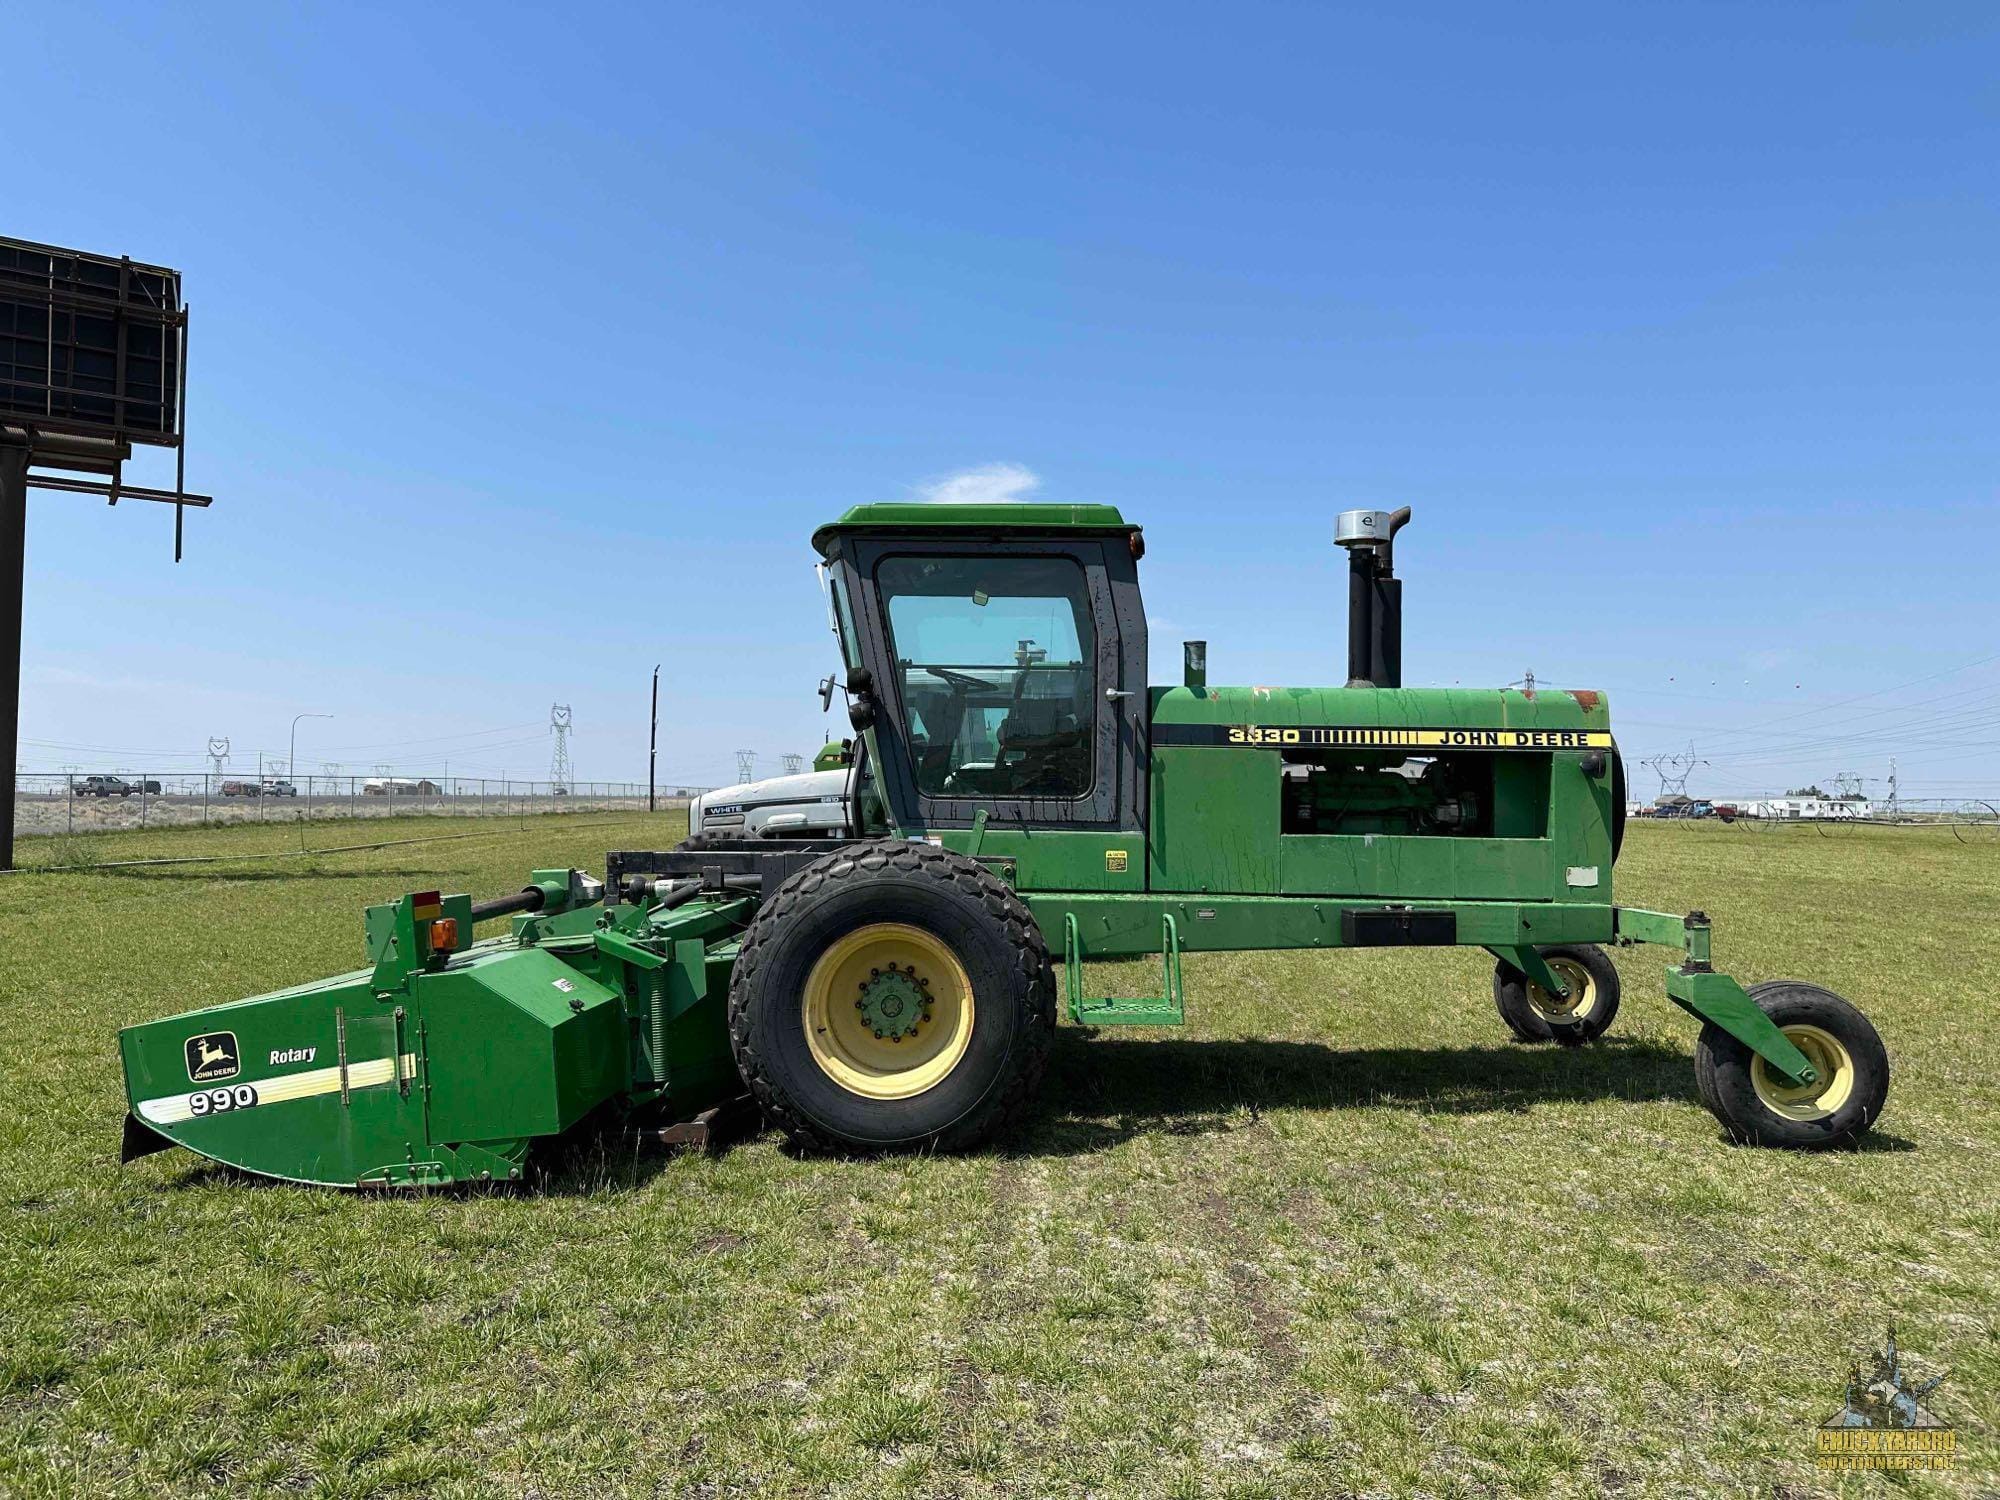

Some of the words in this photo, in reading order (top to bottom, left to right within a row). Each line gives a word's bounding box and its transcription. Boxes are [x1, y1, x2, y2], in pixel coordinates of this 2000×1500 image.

[1440, 731, 1499, 745] JOHN
[1515, 733, 1588, 746] DEERE
[710, 805, 743, 815] WHITE
[269, 1047, 316, 1065] Rotary
[193, 1070, 214, 1080] JOHN
[213, 1066, 237, 1077] DEERE
[189, 1084, 258, 1117] 990
